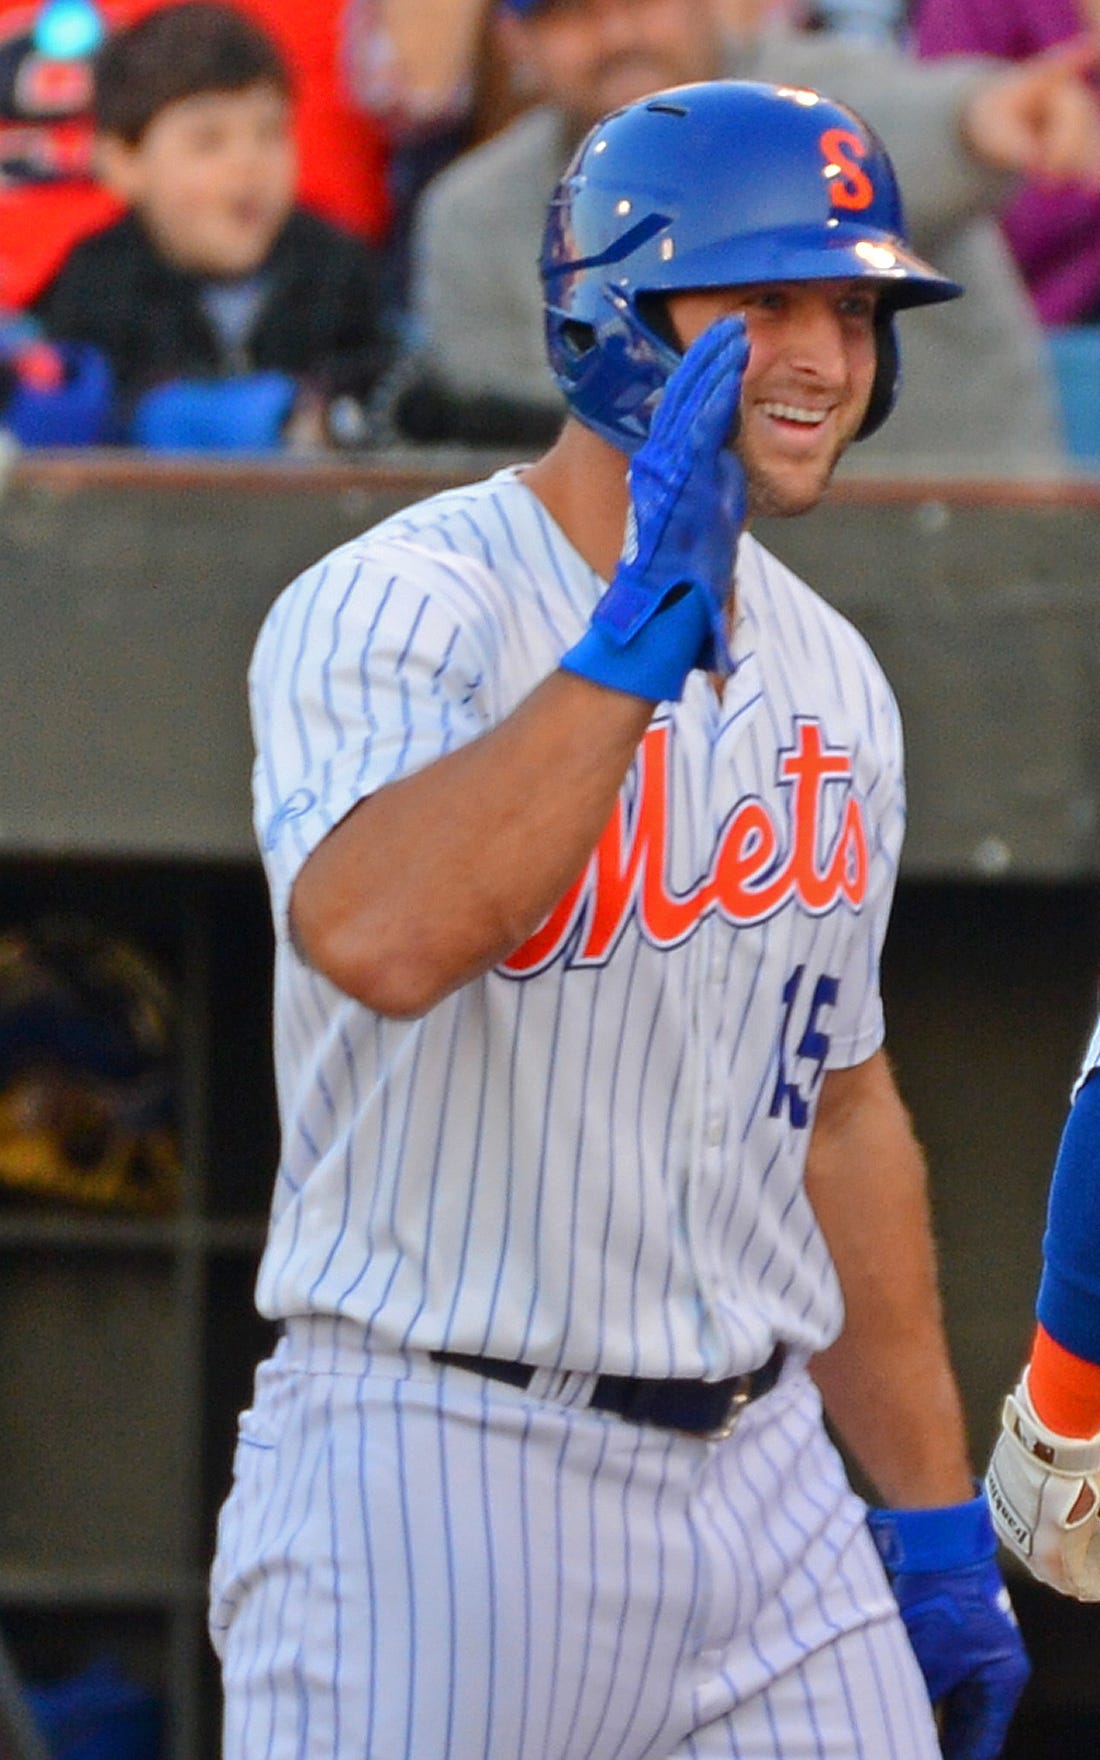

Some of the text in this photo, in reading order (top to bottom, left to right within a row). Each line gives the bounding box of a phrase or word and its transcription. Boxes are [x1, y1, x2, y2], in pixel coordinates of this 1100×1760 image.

[820, 130, 874, 211] S
[495, 716, 871, 980] Mets
[768, 964, 841, 1130] 15
